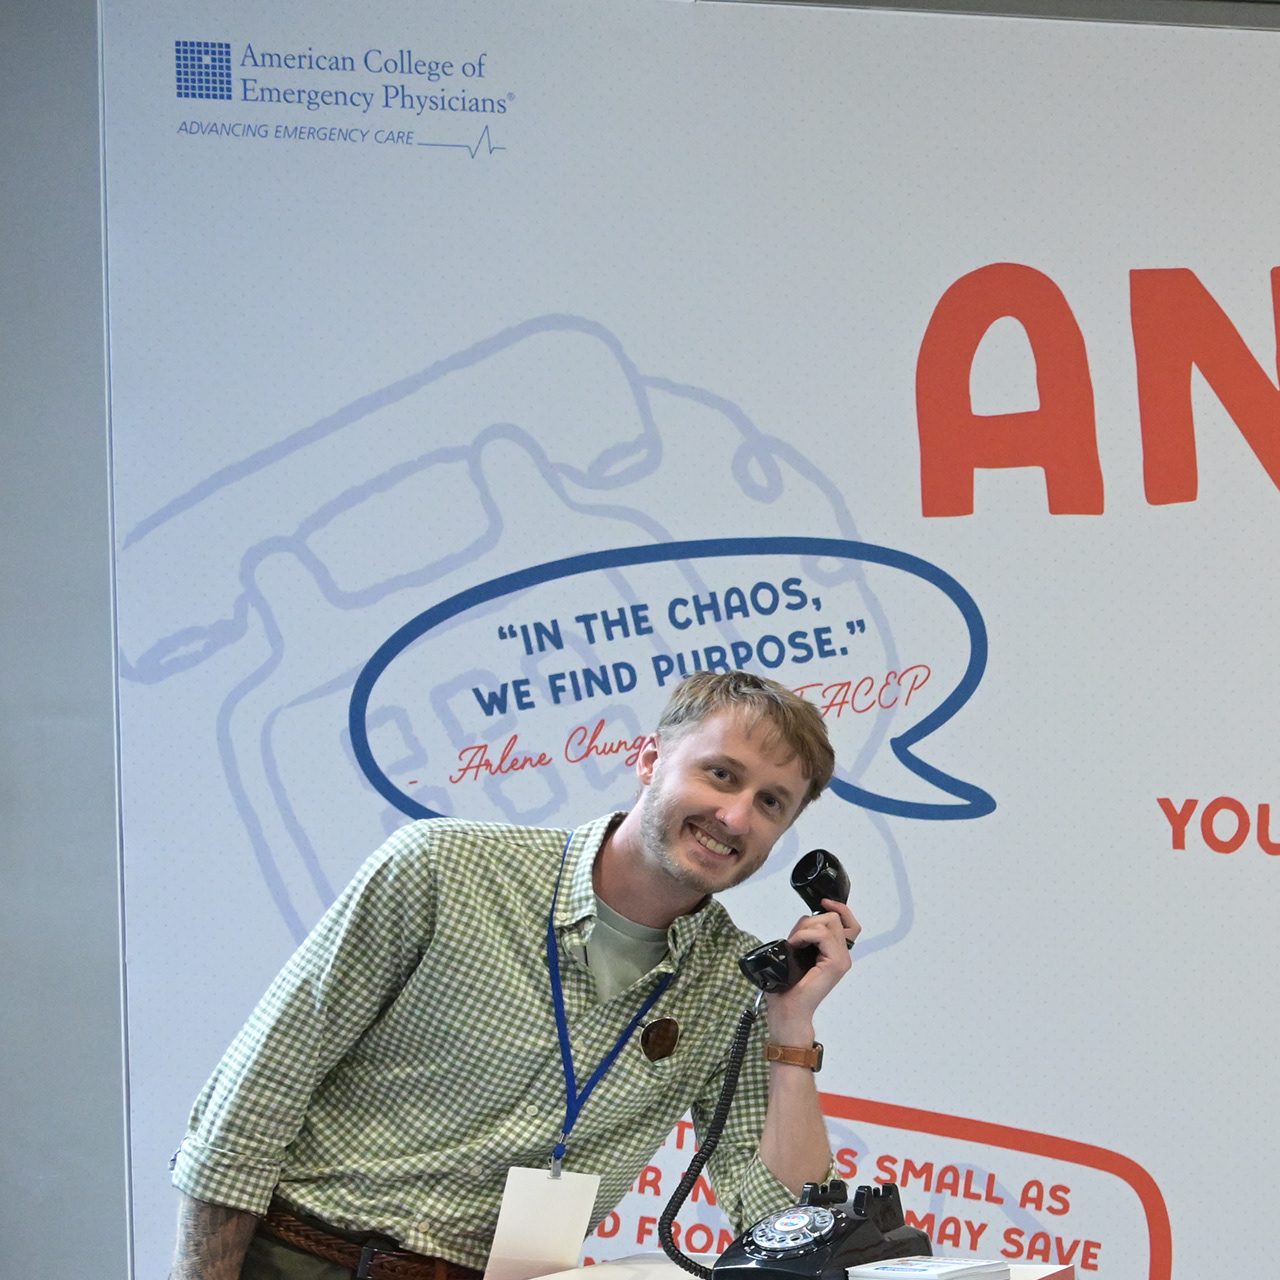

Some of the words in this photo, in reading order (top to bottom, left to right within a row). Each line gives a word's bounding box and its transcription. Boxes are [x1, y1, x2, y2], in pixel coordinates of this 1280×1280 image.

[240, 44, 355, 71] American
[364, 50, 453, 81] College
[462, 53, 487, 77] of
[241, 78, 373, 113] Emergency
[179, 121, 268, 137] ADVANCING
[275, 125, 369, 142] EMERGENCY
[375, 130, 413, 144] CARE
[575, 604, 654, 644] THE
[668, 578, 821, 630] CHAOS,
[472, 678, 535, 716] WE
[548, 662, 637, 705] FIND
[451, 735, 550, 783] Arlene
[874, 1155, 1004, 1204] SMALL
[1020, 1180, 1070, 1215] AS
[1000, 1228, 1101, 1270] SAVE
